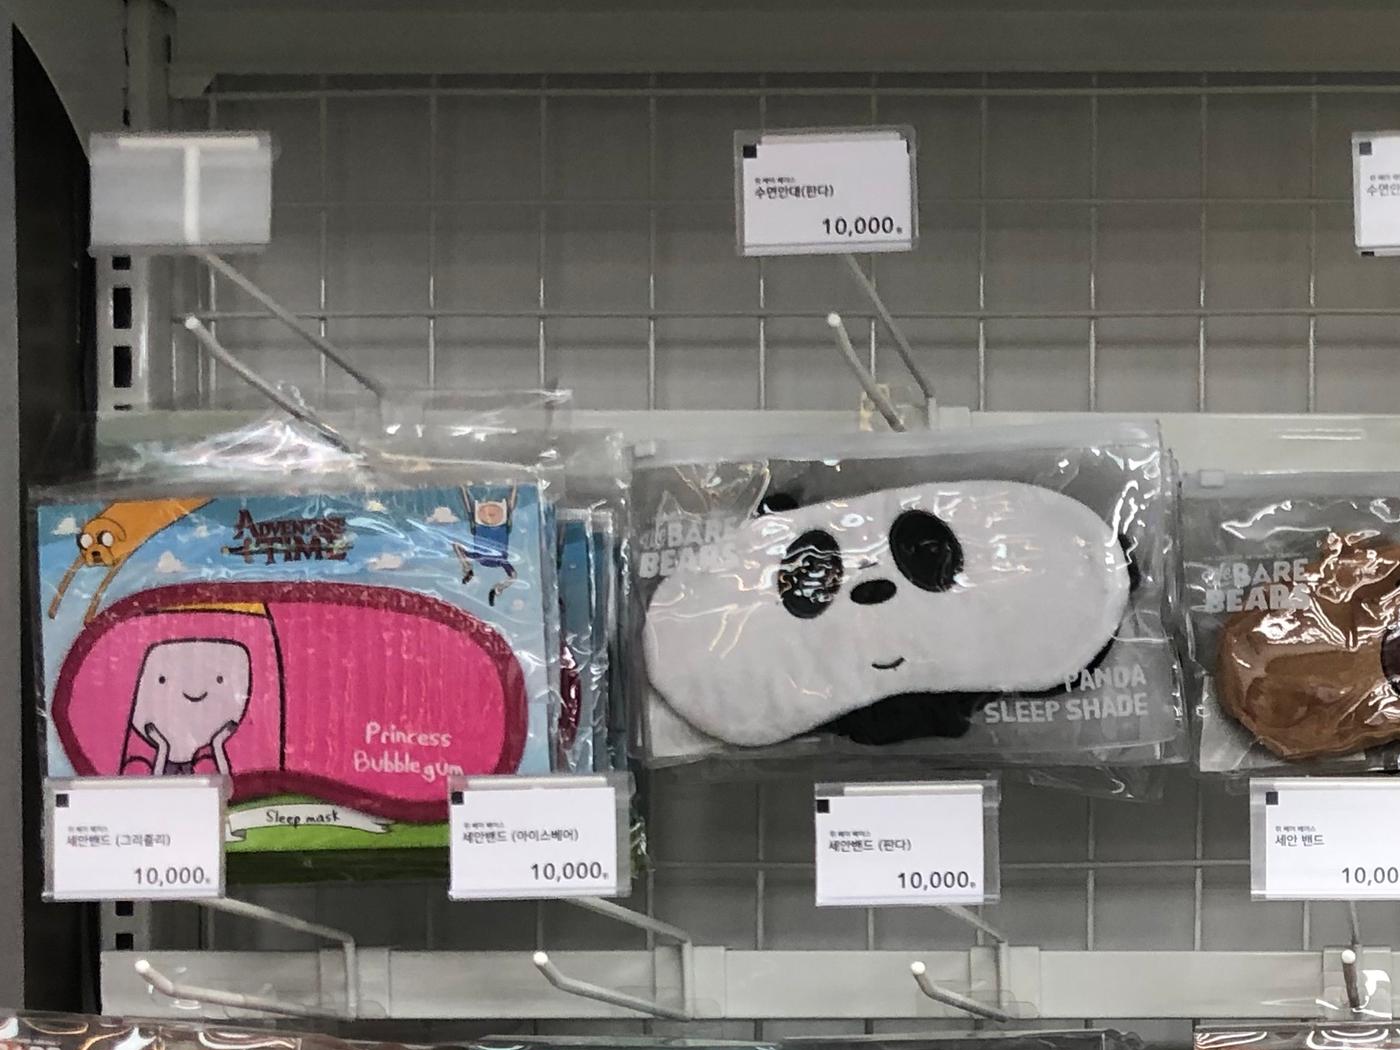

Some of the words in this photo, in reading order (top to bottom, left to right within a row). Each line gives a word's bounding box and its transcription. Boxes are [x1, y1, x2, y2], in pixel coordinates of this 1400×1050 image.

[1232, 558, 1310, 587] BARE
[1205, 583, 1311, 613] BEARS
[1063, 664, 1146, 692] PANDA
[984, 700, 1060, 723] SLEEP
[1065, 692, 1148, 720] SHADE
[365, 721, 453, 748] Princess
[266, 811, 301, 829] Sleep
[306, 809, 341, 823] mask
[1275, 834, 1297, 847] 세안
[1301, 834, 1325, 847] 밴드
